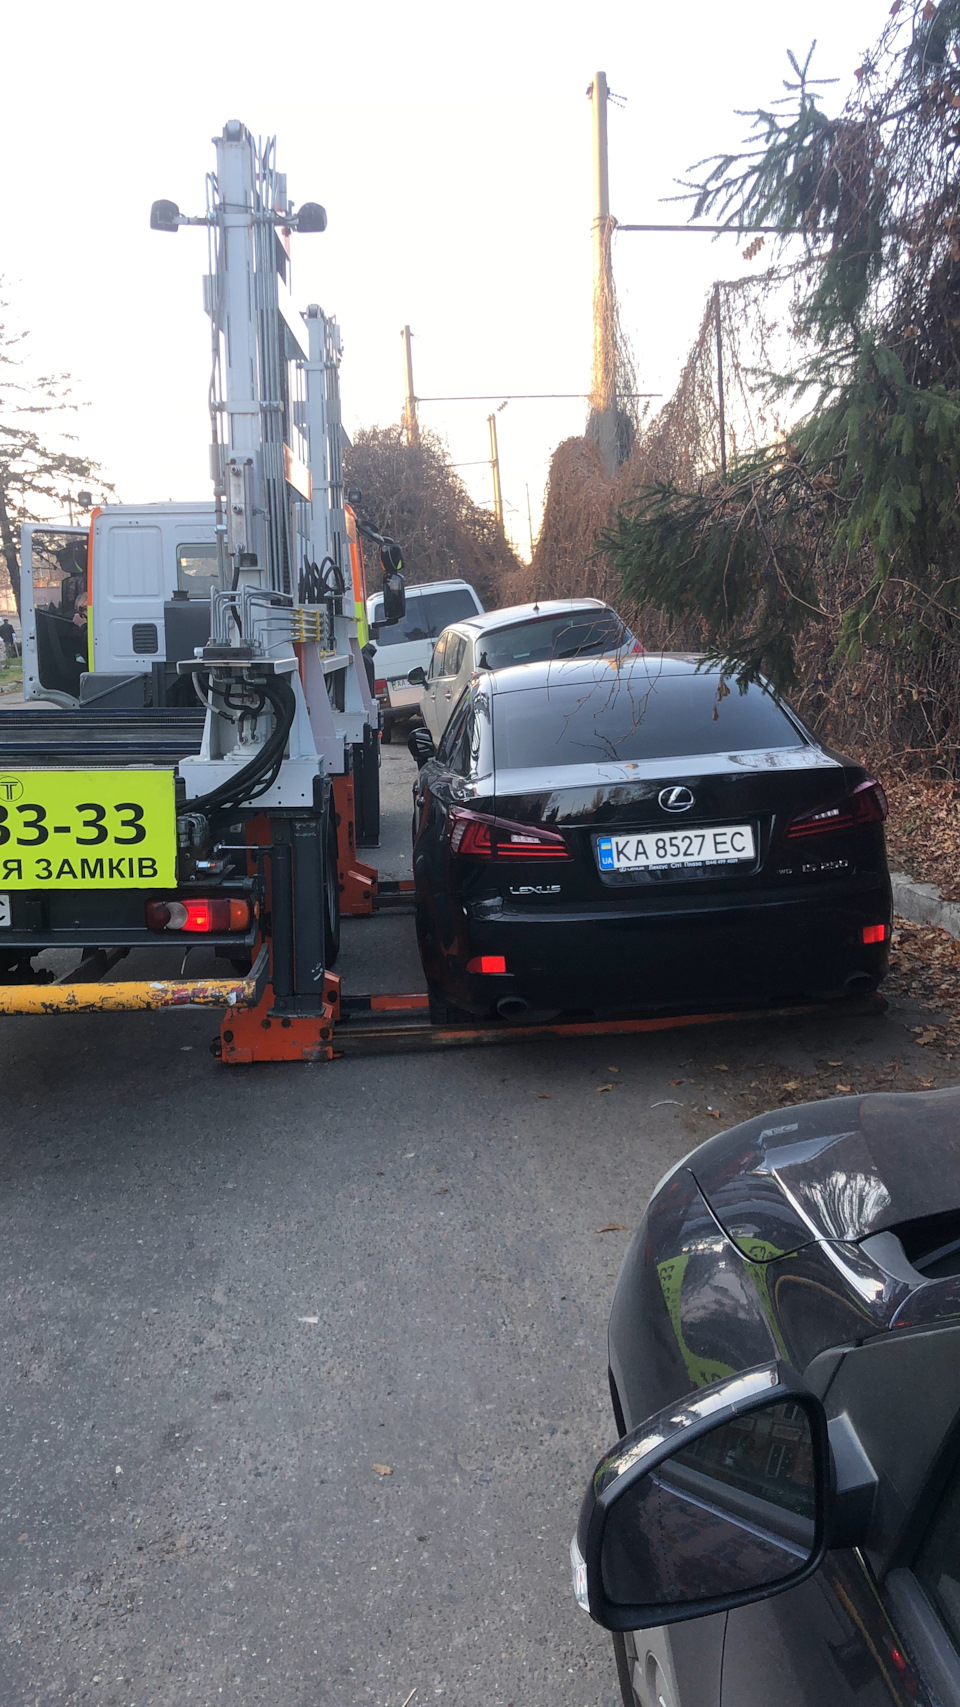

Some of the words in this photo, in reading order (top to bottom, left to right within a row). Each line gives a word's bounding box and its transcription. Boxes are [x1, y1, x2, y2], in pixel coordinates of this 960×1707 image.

[615, 839, 649, 862] KA
[655, 834, 705, 858] 8527
[713, 832, 745, 854] EC
[35, 857, 158, 879] ЗАМКІВ
[602, 857, 613, 865] UA
[510, 885, 561, 895] LEXUS
